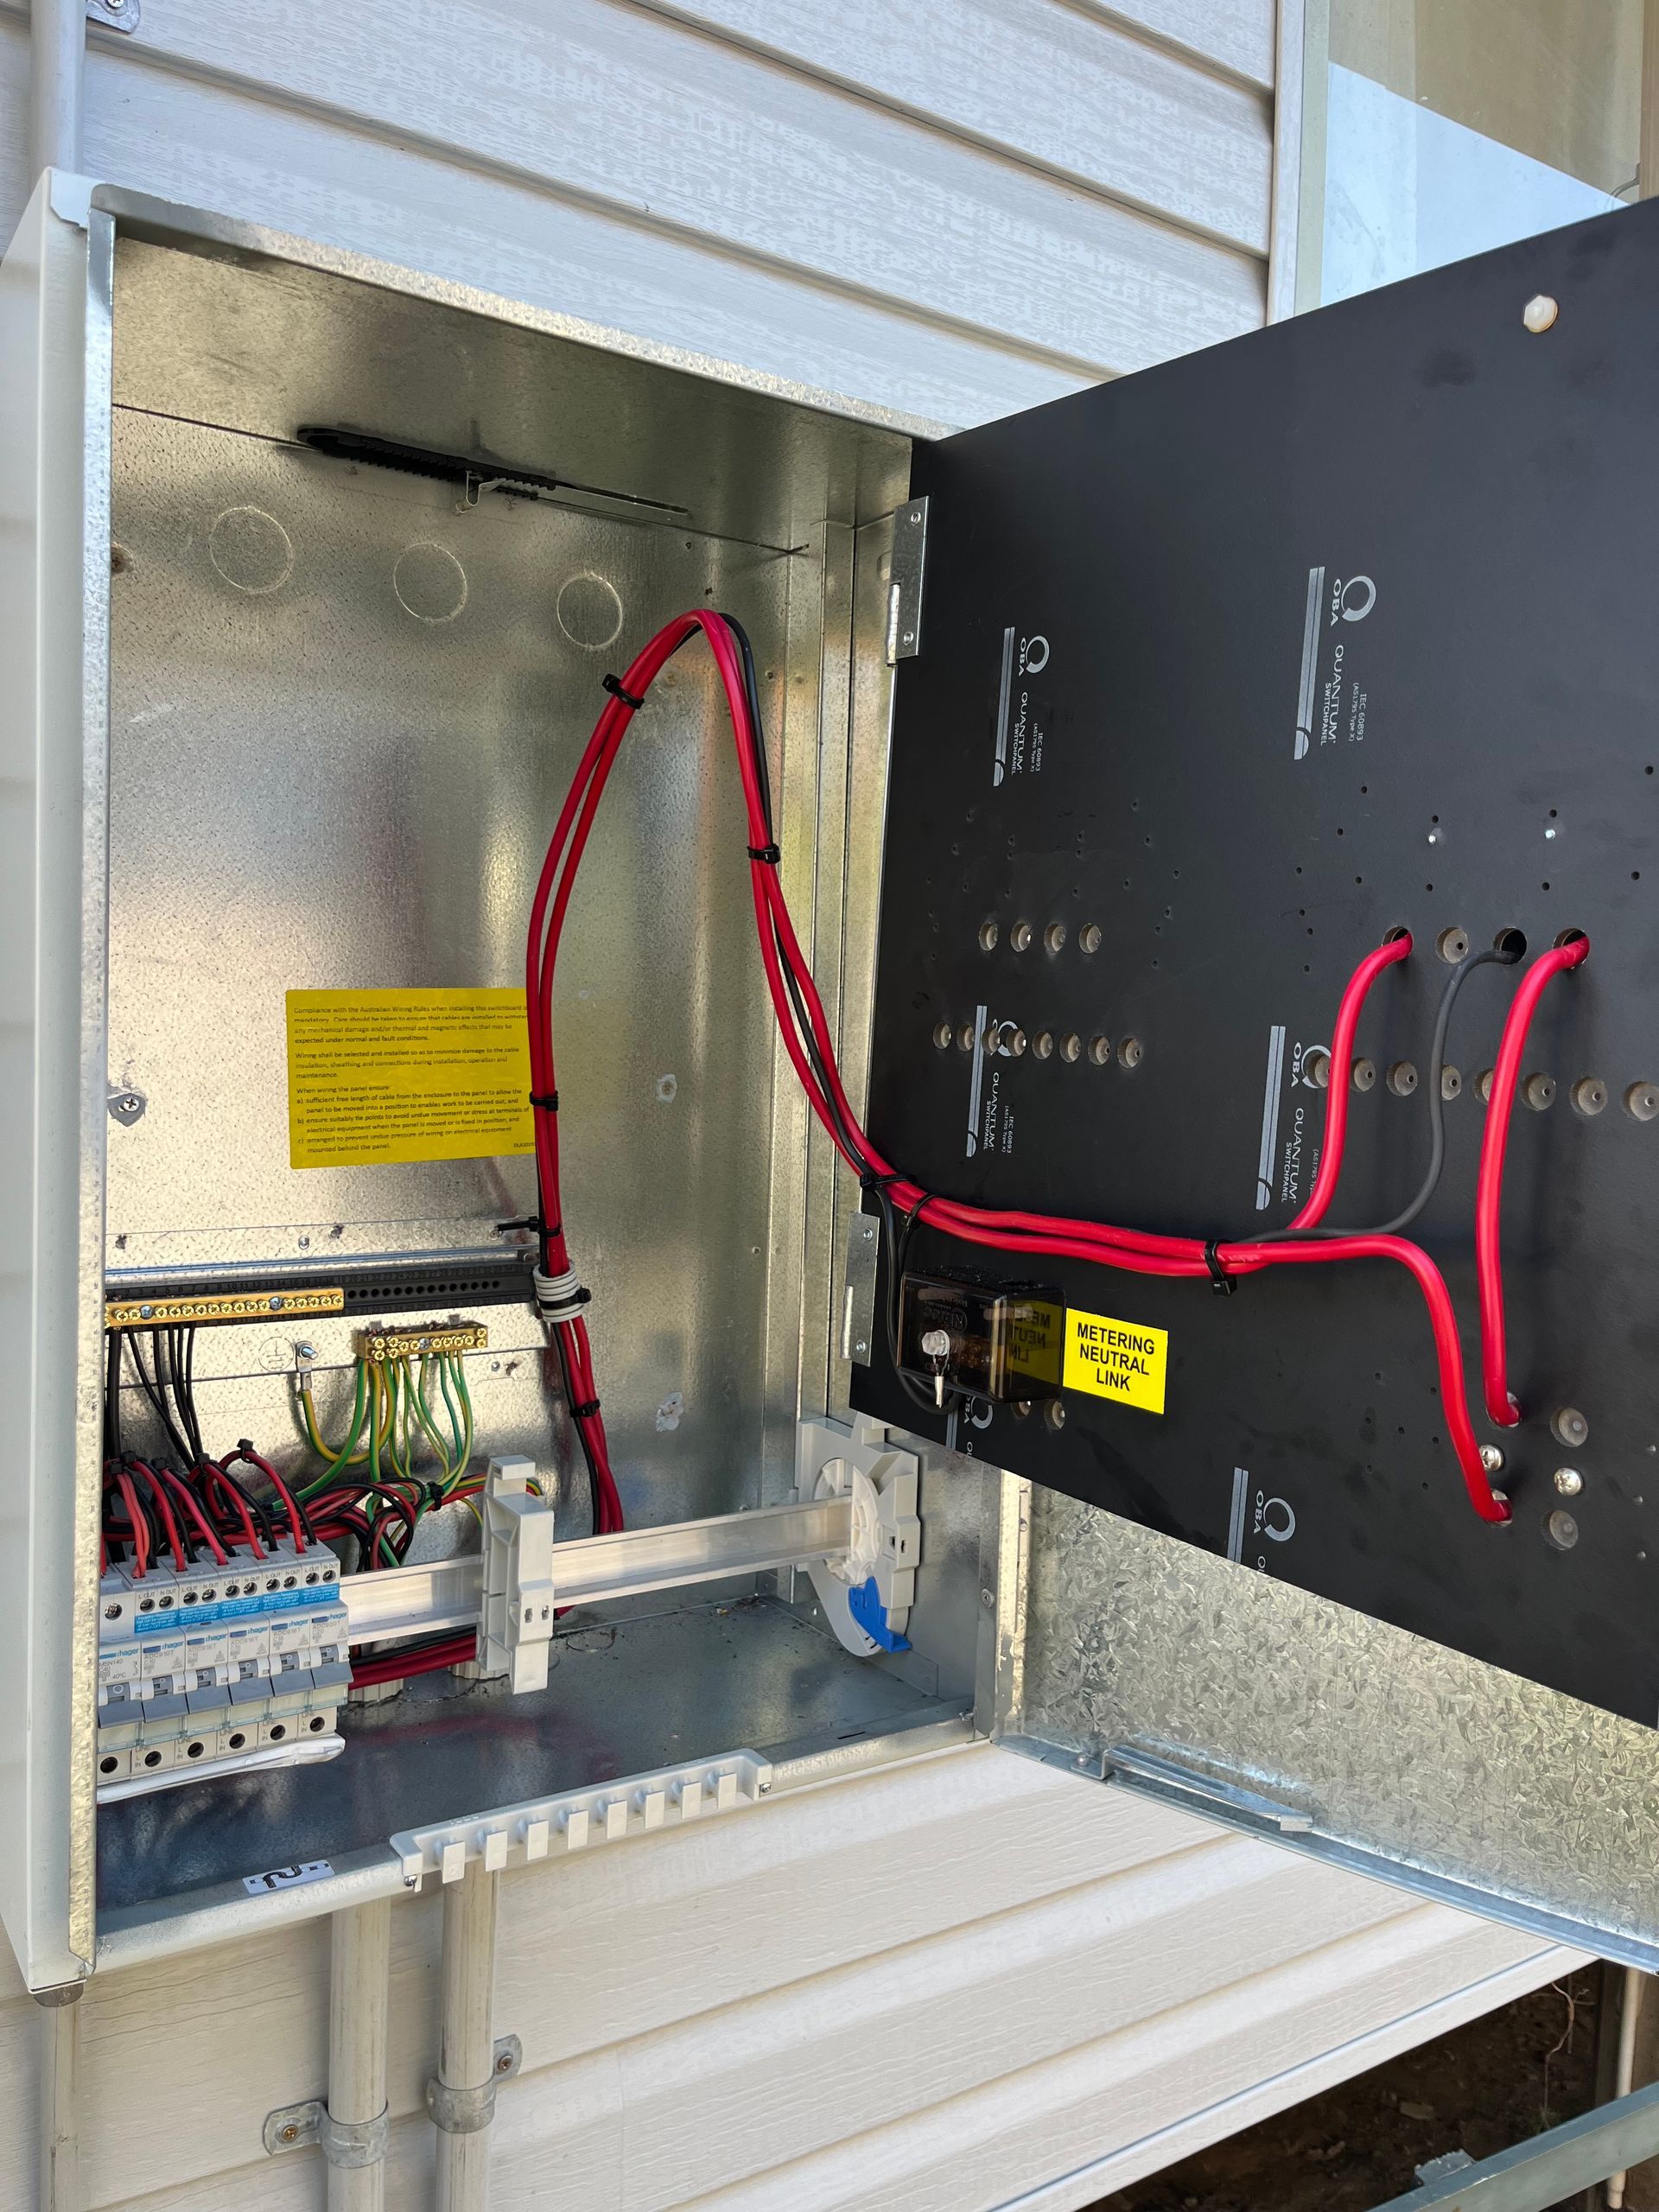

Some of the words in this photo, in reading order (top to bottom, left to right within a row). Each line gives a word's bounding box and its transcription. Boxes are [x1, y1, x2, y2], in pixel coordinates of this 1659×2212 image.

[1331, 579, 1341, 626] OBA
[1018, 638, 1027, 677] OBA
[1320, 683, 1332, 746] SWITCHPANEL
[1328, 645, 1344, 741] QUANTUM
[1011, 723, 1020, 775] SWITCHPANEL
[1016, 691, 1028, 771] QUANTUM
[1357, 713, 1365, 741] 60893
[1291, 1042, 1301, 1087] OBA
[988, 1071, 999, 1148] QUANTUM
[1281, 1142, 1292, 1203] SWITCHPANEL
[1288, 1108, 1304, 1199] QUANTUM
[1077, 1322, 1155, 1355] METERING
[1080, 1344, 1149, 1376] NEUTRAL
[1096, 1368, 1130, 1391] LINK
[1254, 1490, 1264, 1534] OBA
